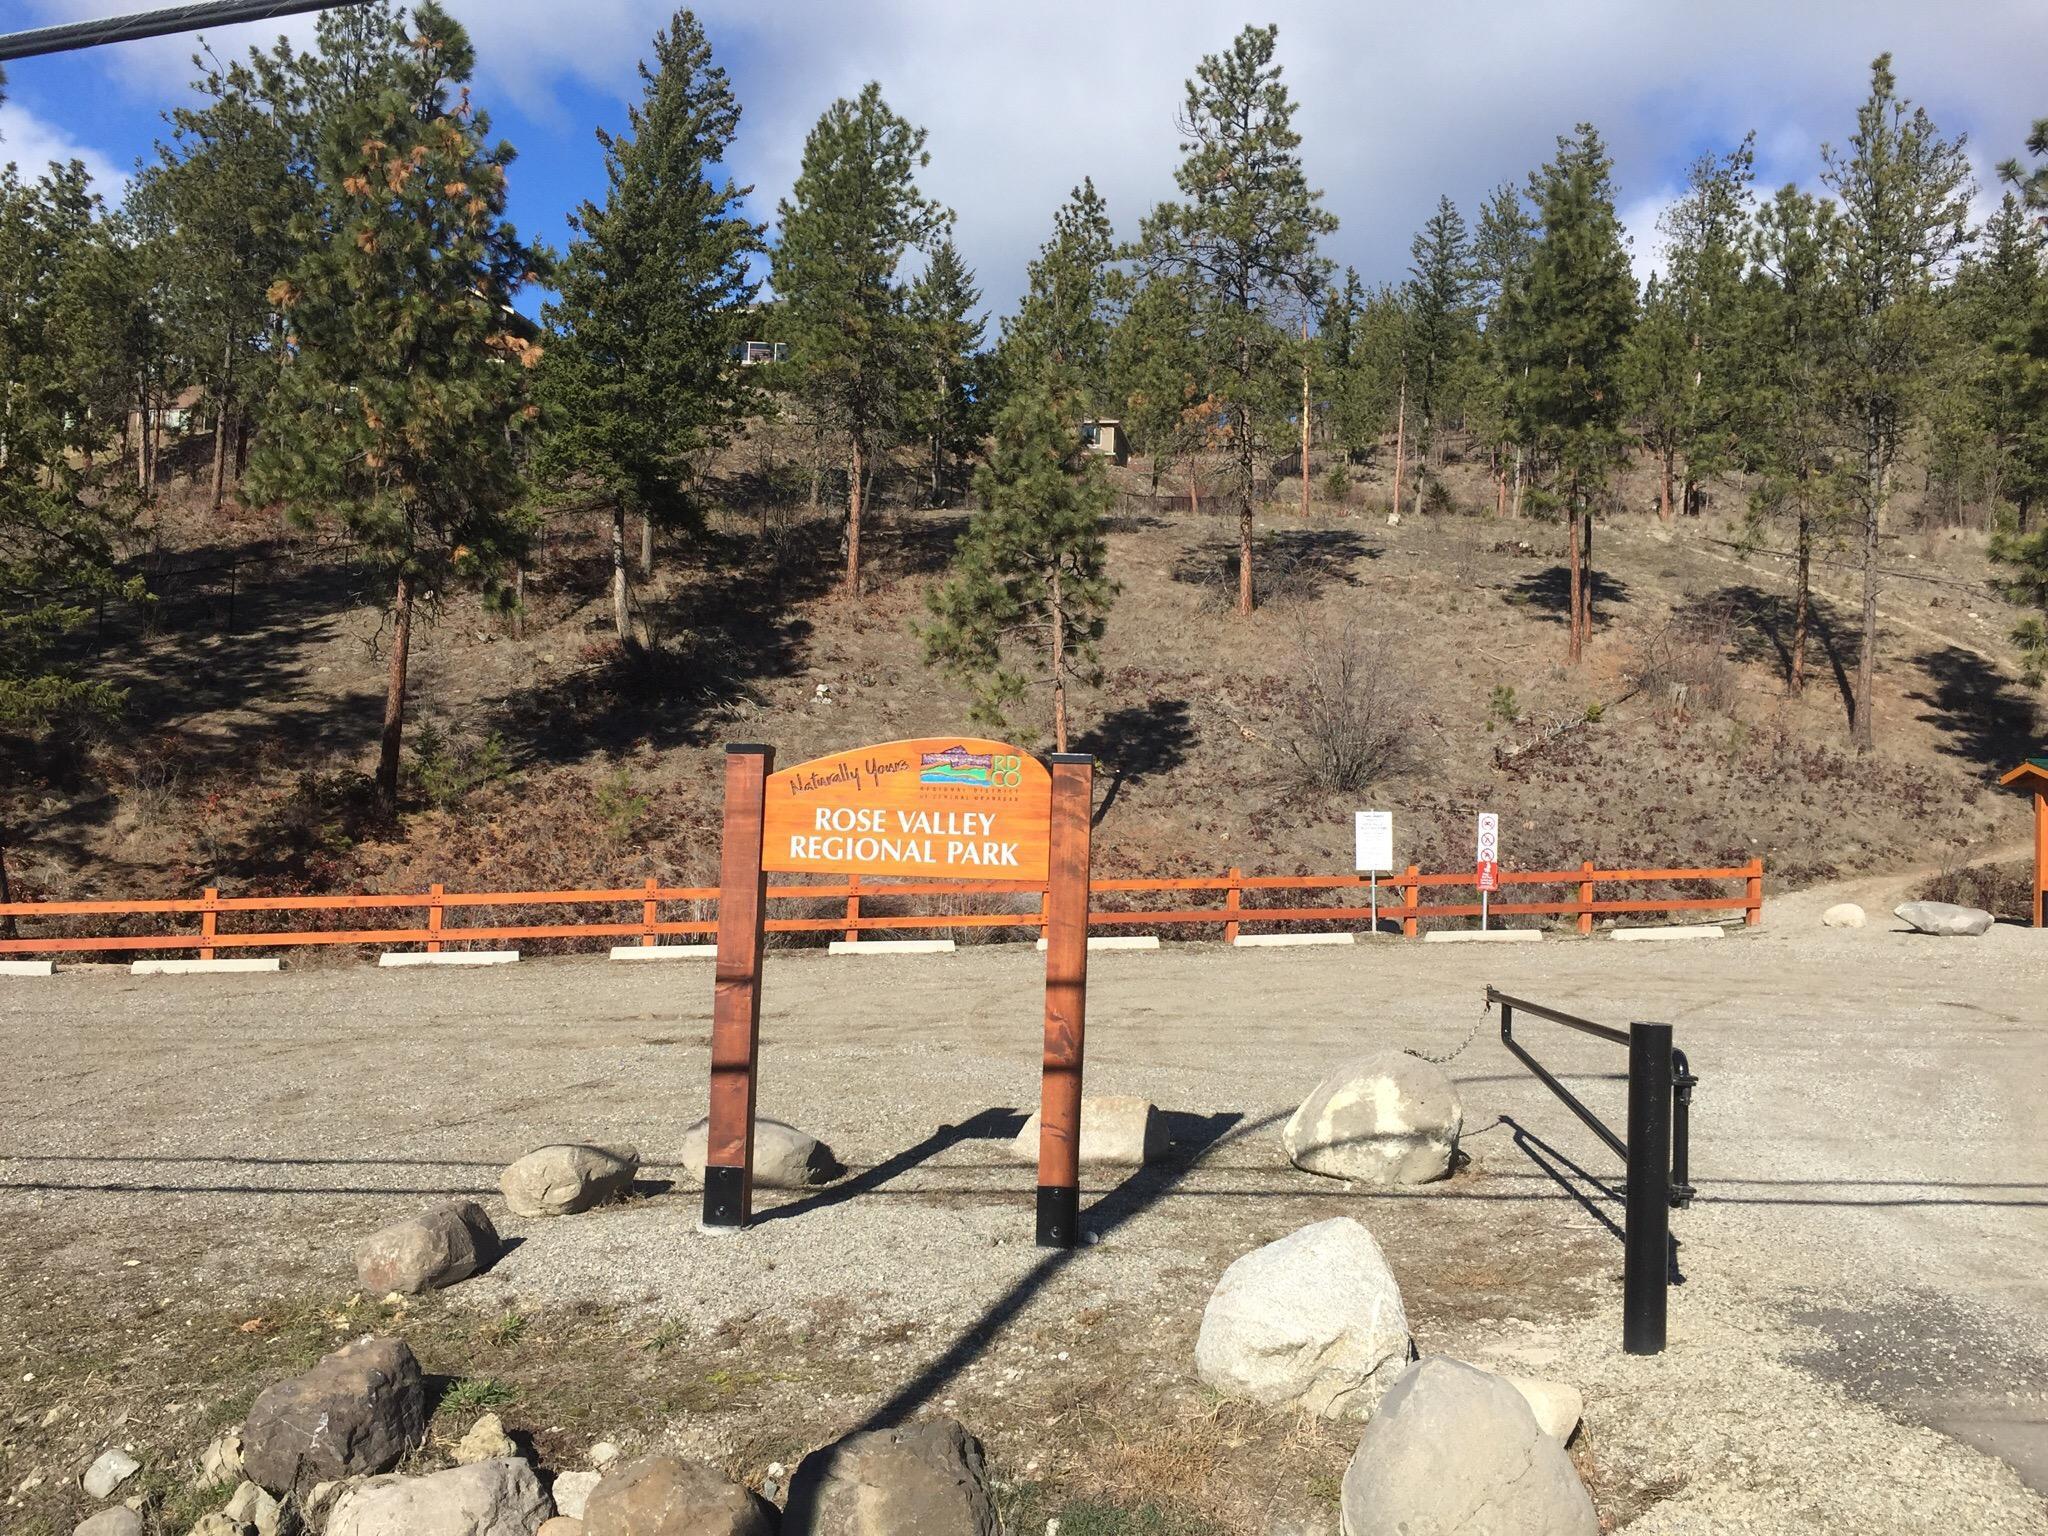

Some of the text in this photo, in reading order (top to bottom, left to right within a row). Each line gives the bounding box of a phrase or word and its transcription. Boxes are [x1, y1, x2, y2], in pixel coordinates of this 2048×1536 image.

[790, 758, 910, 796] Naturally Yours
[815, 807, 996, 837] ROSE VALLEY
[790, 835, 1019, 867] REGIONAL PARK
